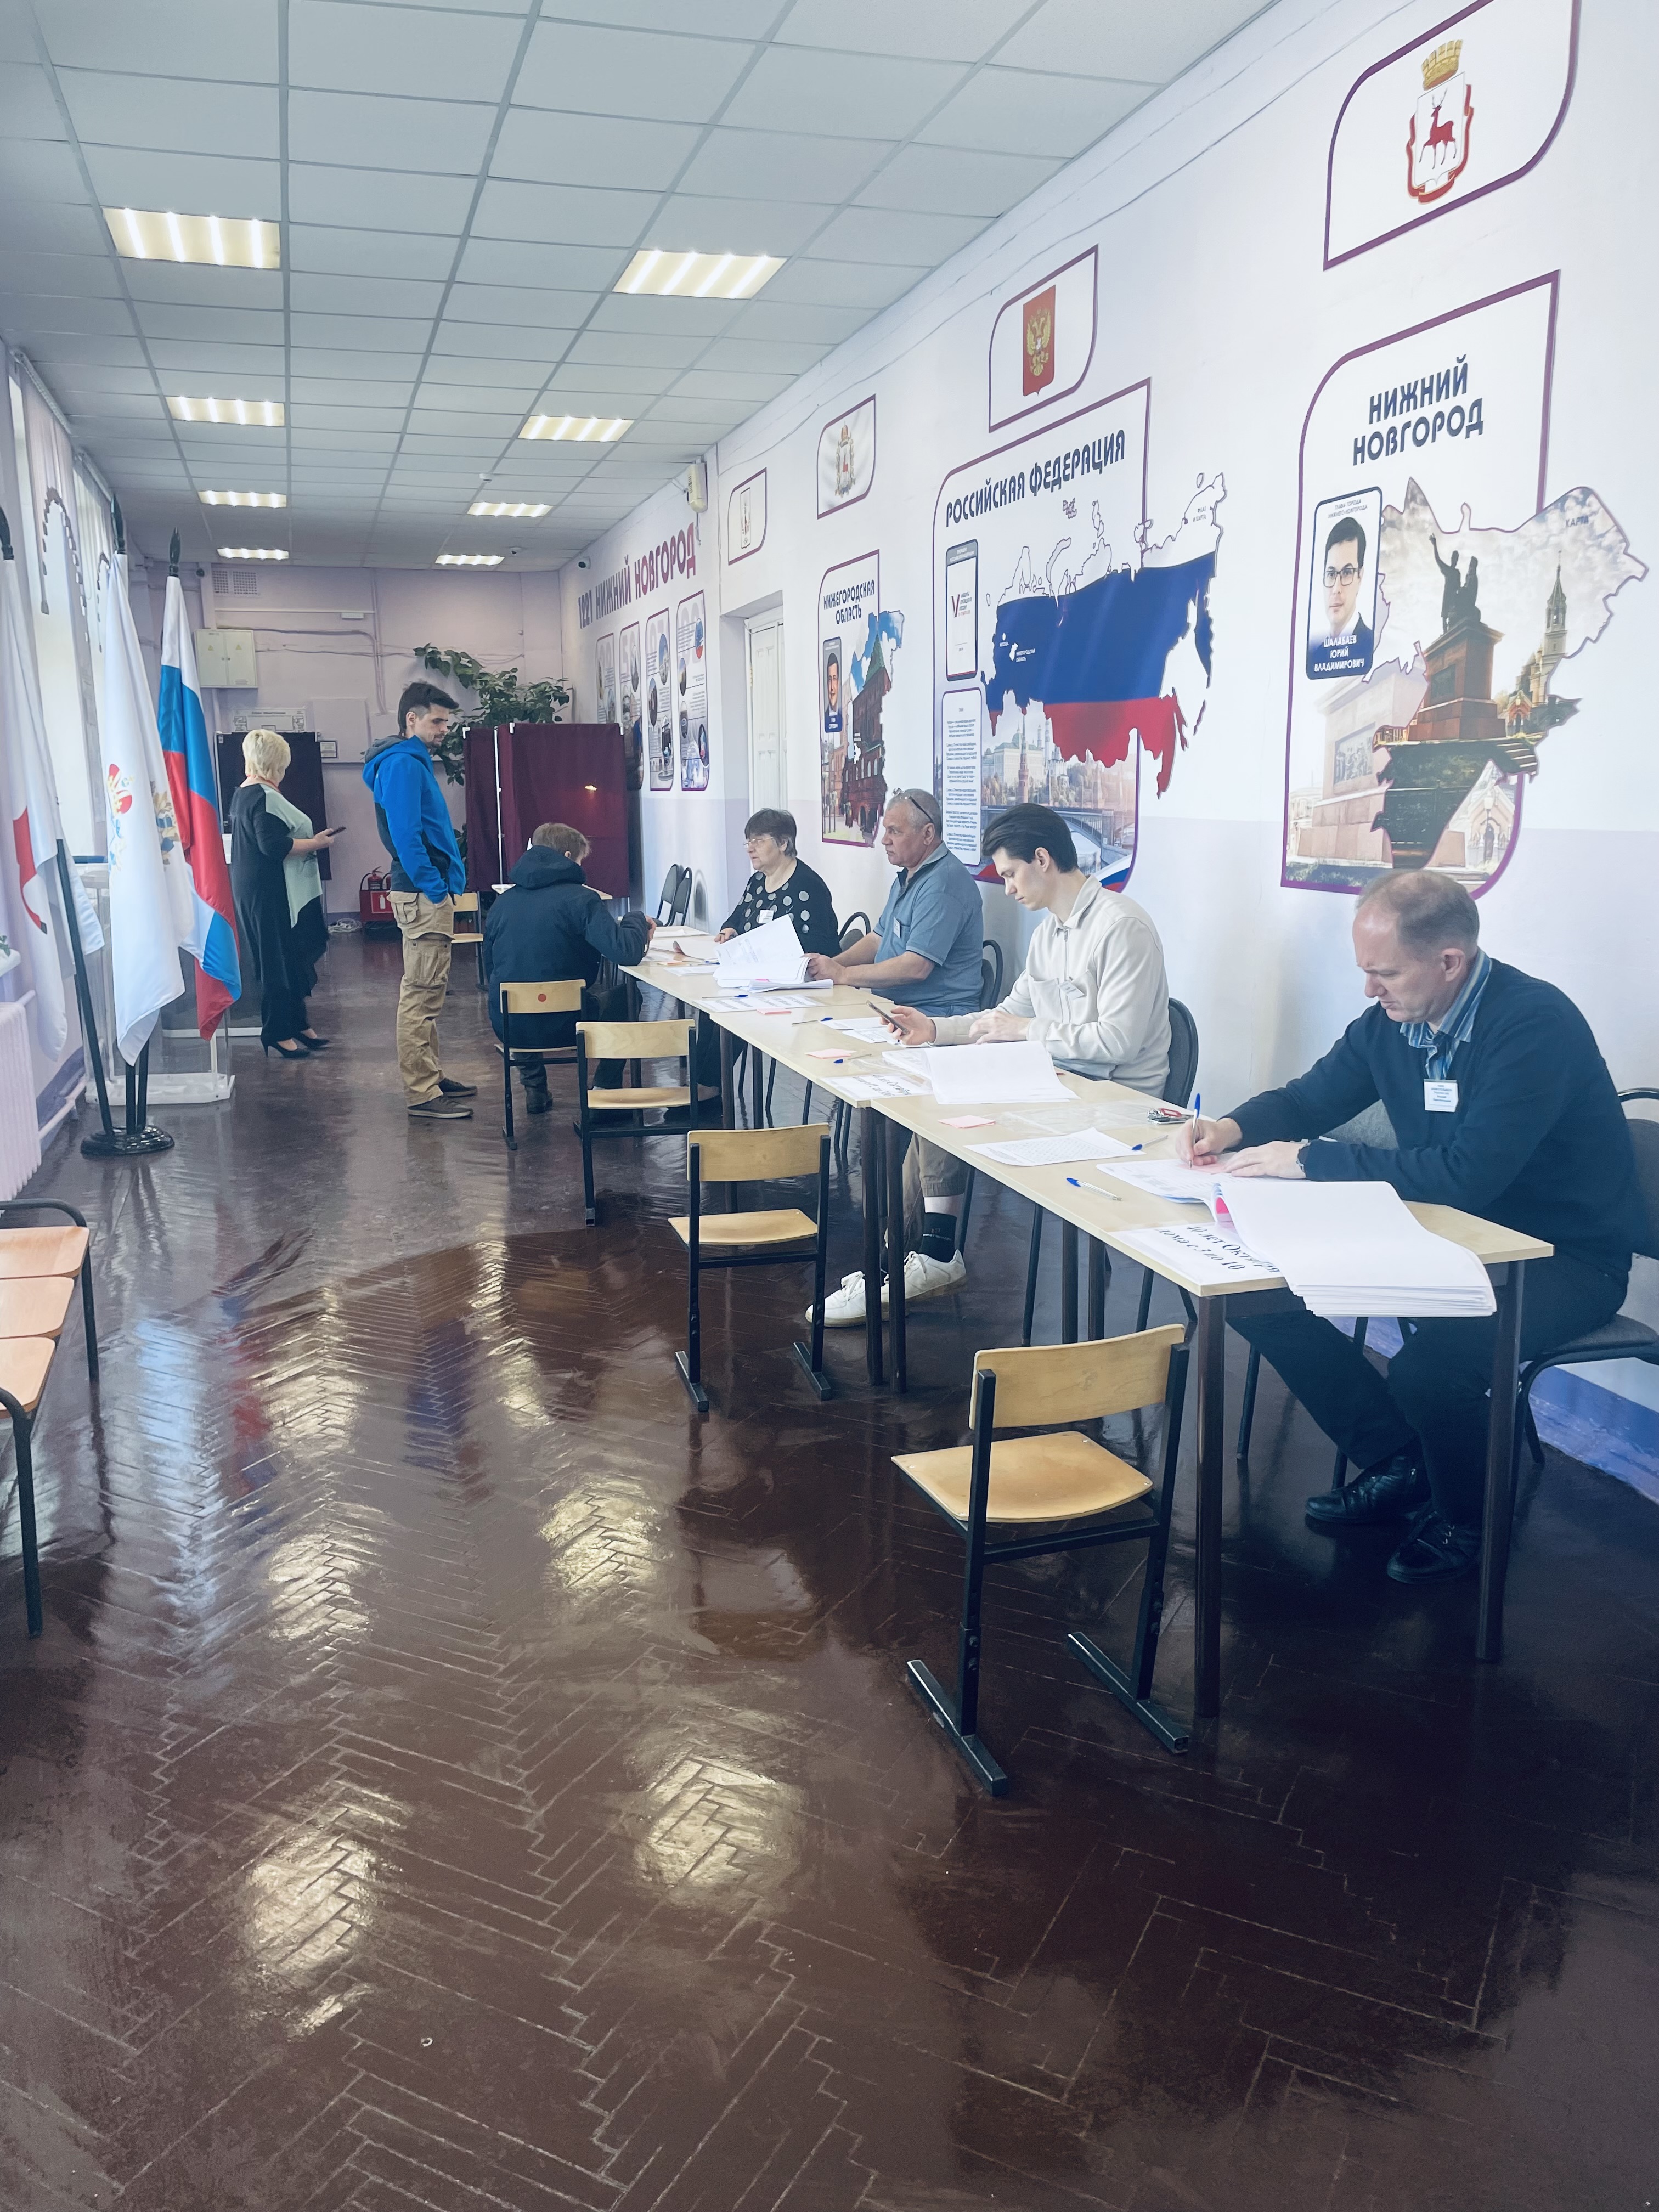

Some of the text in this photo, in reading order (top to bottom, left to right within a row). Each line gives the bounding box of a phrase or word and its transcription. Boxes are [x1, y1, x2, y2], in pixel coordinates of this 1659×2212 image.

[1369, 354, 1468, 425] НИЖНИЙ
[1353, 397, 1483, 466] НОВГОРОД
[946, 430, 1125, 527] РОССИЙСКАЯ ФЕДЕРАЦИЯ
[1565, 516, 1589, 528] КАРТА
[578, 522, 696, 629] 1221 НИЖНИЙ НОВГОРОД
[823, 579, 875, 610] НИЖЕГОРОДСКАЯ
[836, 603, 862, 624] ОБЛАСТЬ
[1323, 635, 1357, 647] ШАЛАБАЕВ
[1330, 646, 1349, 658] ЮРИЙ
[1314, 658, 1365, 672] ВЛАДИМИРОВИЧ
[1198, 1233, 1227, 1244] лет
[1222, 1244, 1280, 1273] Октября
[1221, 1261, 1246, 1271] 10
